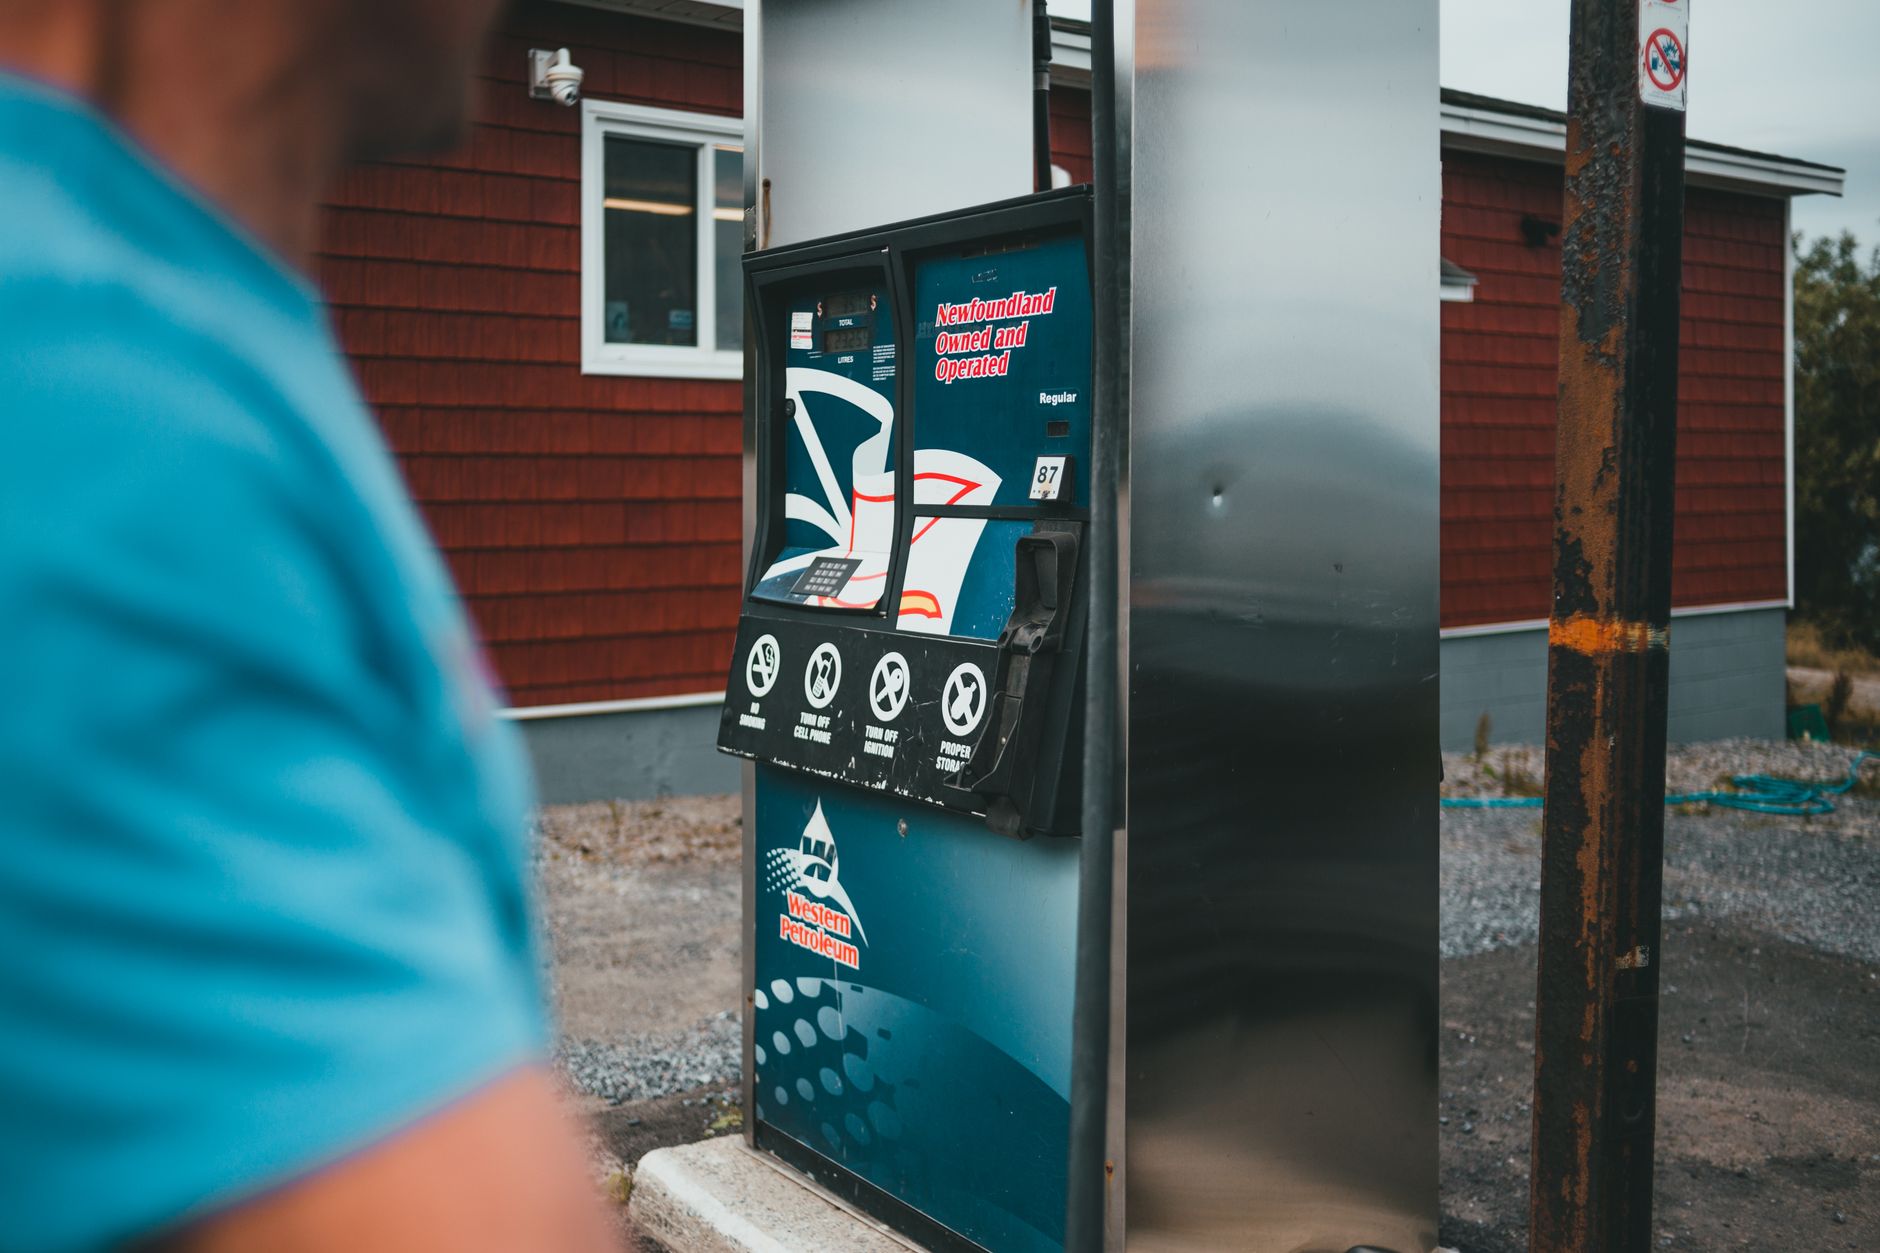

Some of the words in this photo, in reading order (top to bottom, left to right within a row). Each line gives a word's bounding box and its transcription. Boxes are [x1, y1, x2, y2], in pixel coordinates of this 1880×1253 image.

[935, 286, 1057, 327] Newfoundland
[935, 325, 992, 355] Owned
[994, 321, 1029, 349] and
[837, 356, 854, 364] LITRES
[935, 350, 1011, 384] Operated
[1040, 392, 1077, 406] Regular
[1037, 466, 1058, 484] 87
[750, 701, 760, 715] NO
[739, 713, 766, 730] SMOKING
[800, 711, 817, 726] TURN
[817, 716, 830, 729] OFF
[793, 725, 809, 741] CELL
[809, 728, 832, 744] PHONE
[865, 725, 884, 740] TURN
[884, 728, 899, 742] OFF
[863, 740, 895, 759] IGNITION
[940, 740, 971, 759] PROPER
[786, 887, 851, 939] Western
[780, 913, 860, 970] Petroleum
